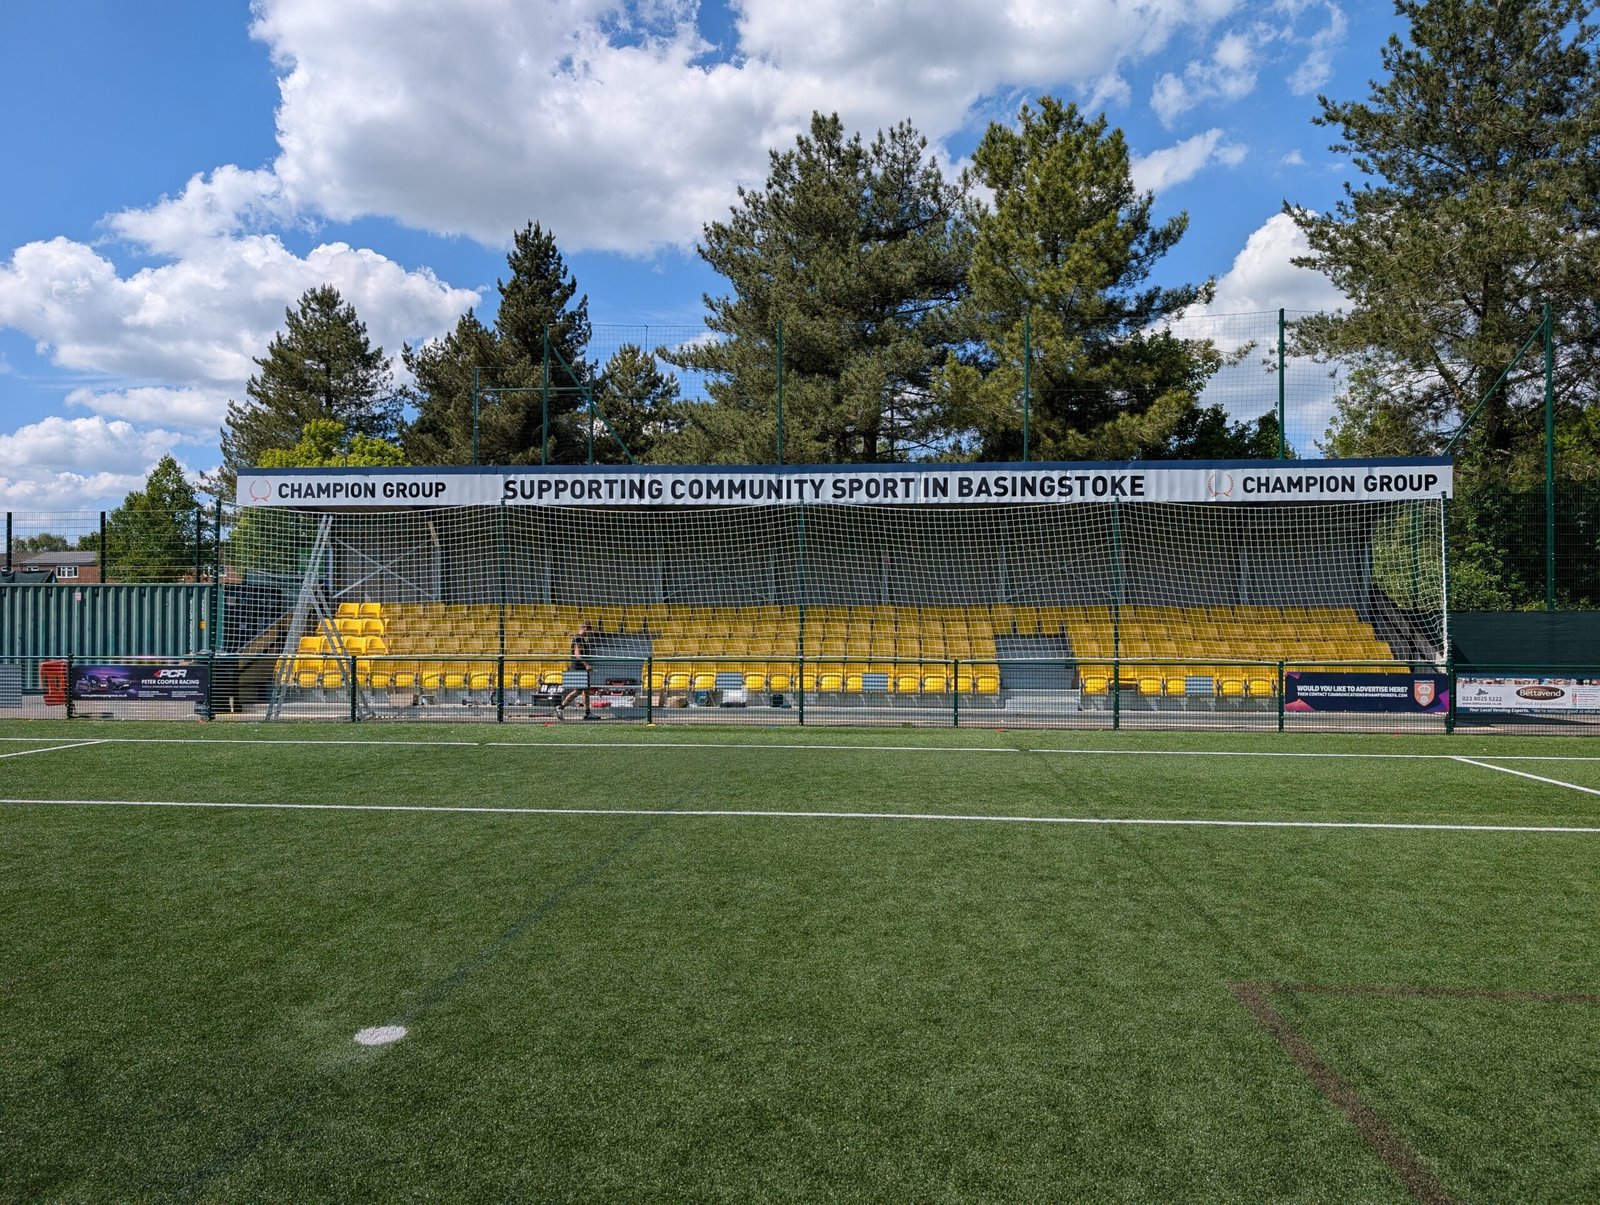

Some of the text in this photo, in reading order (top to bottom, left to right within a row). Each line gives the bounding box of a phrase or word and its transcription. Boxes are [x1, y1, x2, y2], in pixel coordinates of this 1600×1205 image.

[278, 481, 446, 499] CHAMPION GROUP
[504, 475, 1145, 500] SUPPORTING COMMUNITY SPORT IN BASINGSTOKE
[1242, 474, 1438, 494] CHAMPION GROUP
[159, 669, 187, 678] PCR
[1355, 685, 1388, 693] ADVERTISE
[1520, 689, 1561, 697] Bettavend
